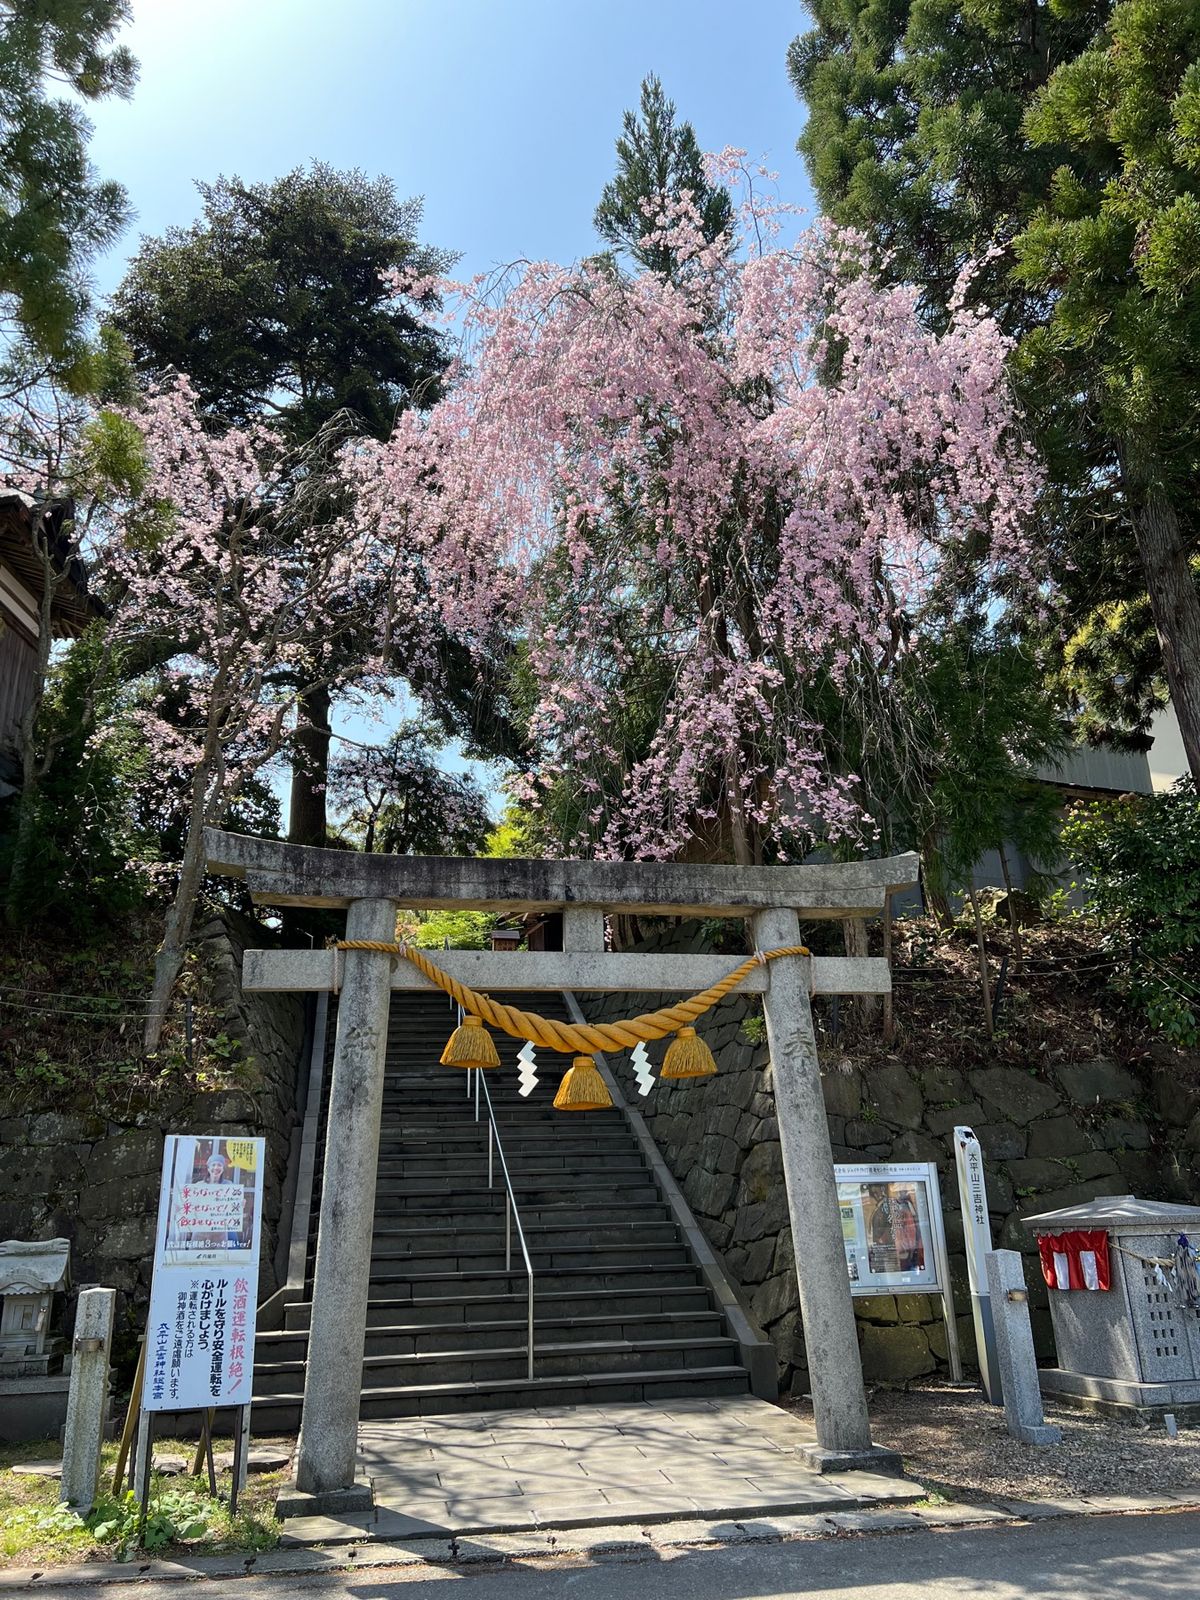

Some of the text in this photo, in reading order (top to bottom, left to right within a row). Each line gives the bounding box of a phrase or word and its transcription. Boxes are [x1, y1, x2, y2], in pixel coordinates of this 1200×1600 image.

[968, 1153, 985, 1225] 太平山三吉神社
[152, 1322, 170, 1400] 太平山三吉神社総本宮
[169, 1291, 188, 1400] 御神酒をご遠慮願います。
[197, 1279, 214, 1353] 心がけましょう。
[210, 1279, 228, 1397] ルールを守り安全運転を
[227, 1278, 249, 1395] 飲酒運転根絶！
